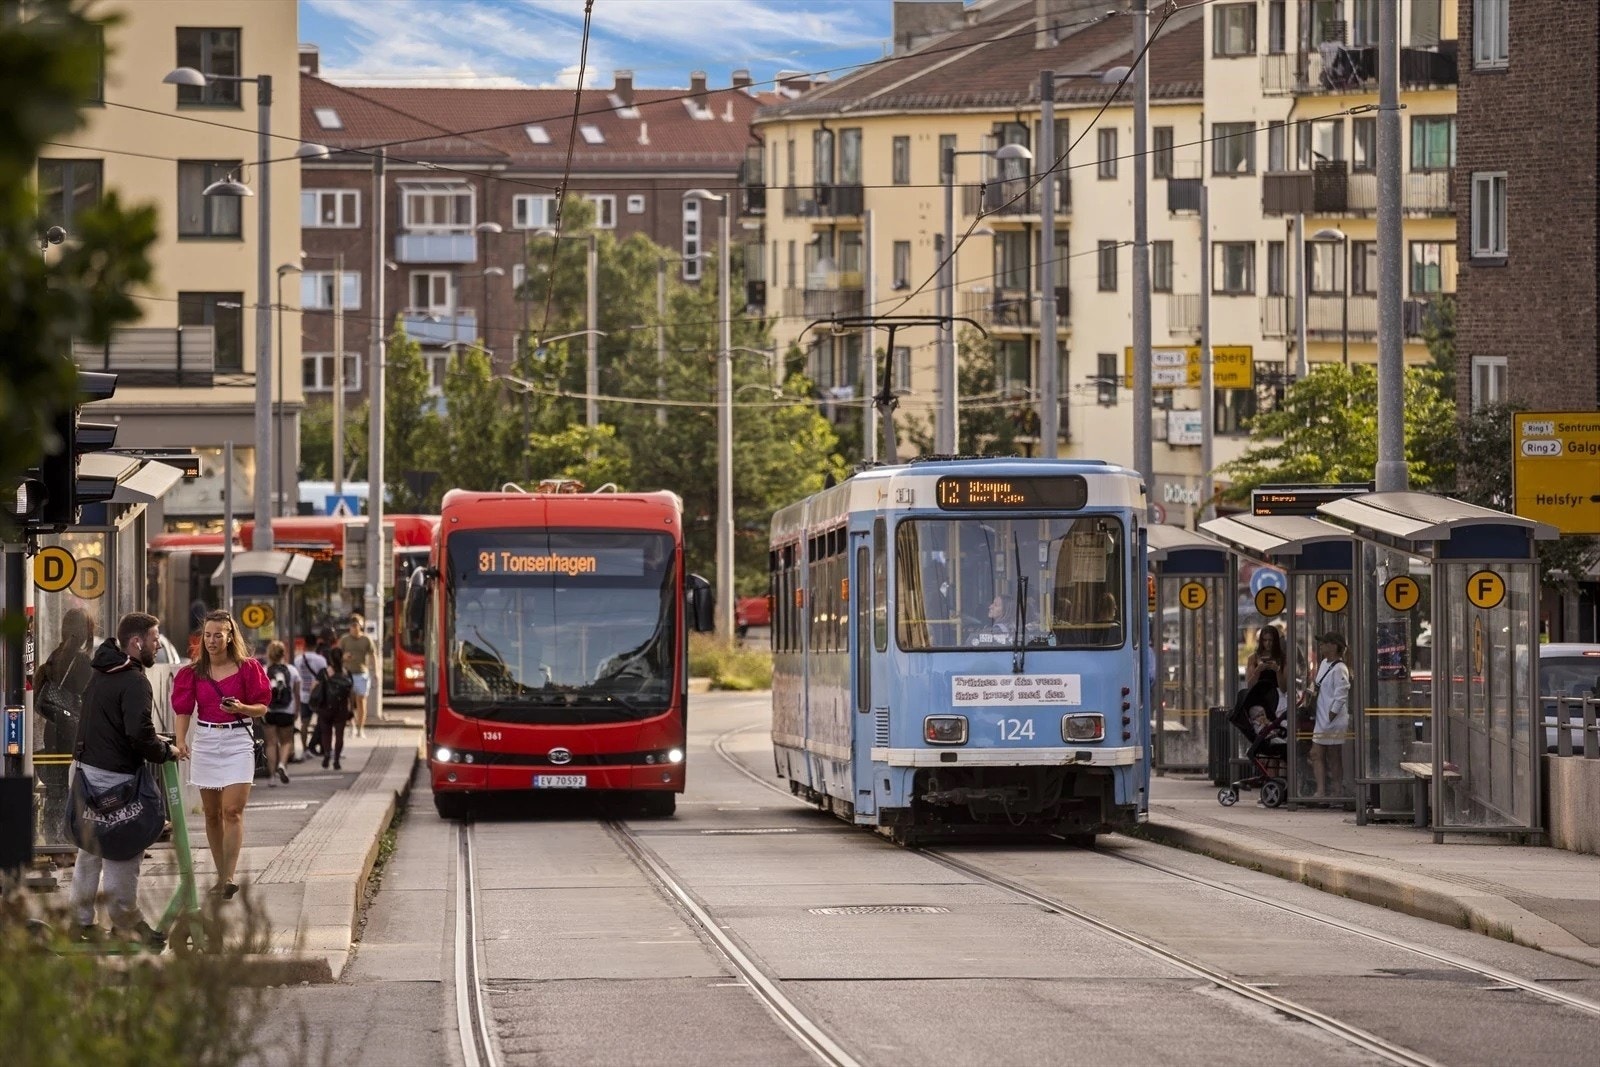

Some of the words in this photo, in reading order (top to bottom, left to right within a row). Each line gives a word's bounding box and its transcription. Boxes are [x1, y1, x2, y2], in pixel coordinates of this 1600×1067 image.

[1528, 425, 1545, 433] Ring
[1527, 443, 1548, 454] Ring
[1550, 443, 1556, 452] 2
[1568, 441, 1600, 455] Galg
[1536, 494, 1584, 507] Helsfyr
[44, 556, 64, 582] D
[479, 552, 496, 571] 31
[500, 552, 596, 576] Tonsenhagen
[80, 567, 98, 590] D
[1187, 588, 1198, 604] E
[1326, 587, 1339, 605] F
[1395, 583, 1409, 603] F
[1478, 578, 1493, 600] F
[1264, 593, 1276, 610] F
[248, 610, 258, 623] C
[955, 676, 998, 687] Trikken
[1000, 678, 1012, 687] er
[1014, 676, 1033, 686] din
[955, 691, 979, 700] ikke
[1018, 690, 1040, 699] med
[1044, 690, 1066, 699] den
[483, 731, 502, 741] 1361
[997, 719, 1036, 740] 124
[541, 776, 553, 786] EV
[556, 776, 584, 786] 70592
[169, 786, 180, 806] Bolt
